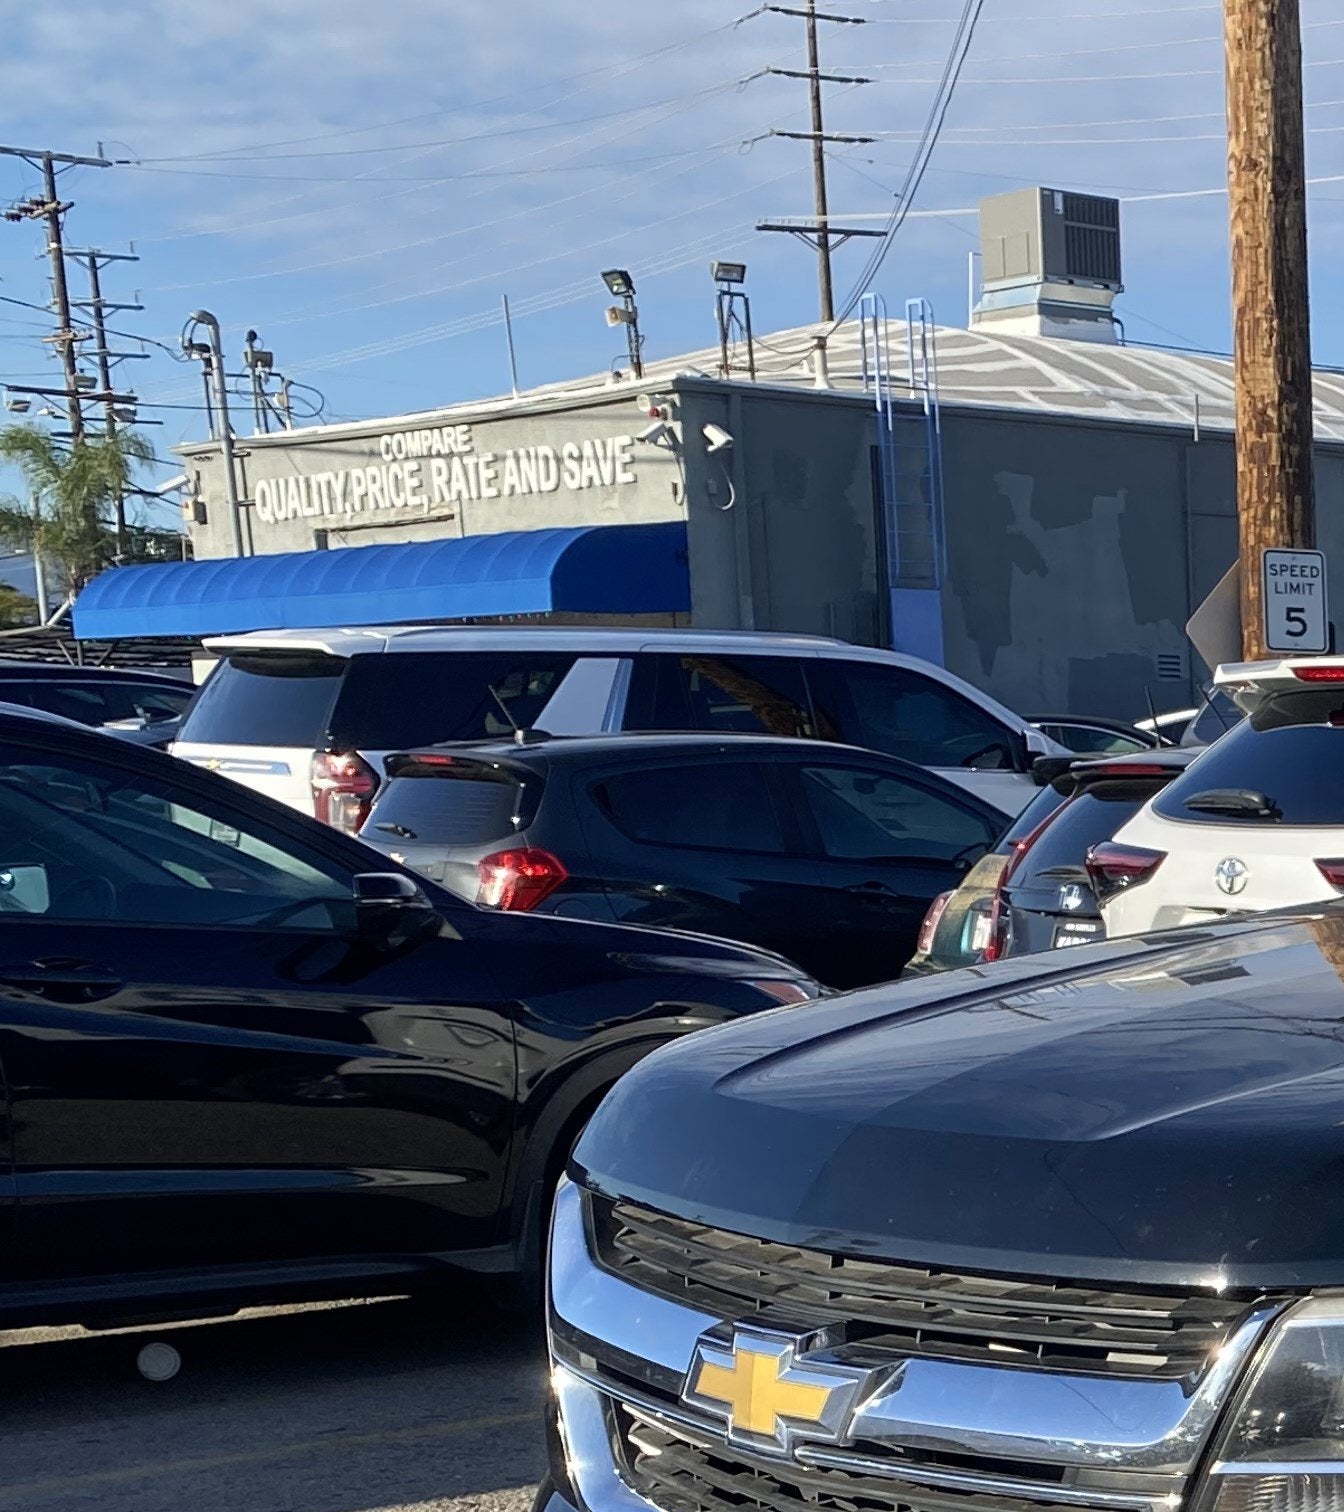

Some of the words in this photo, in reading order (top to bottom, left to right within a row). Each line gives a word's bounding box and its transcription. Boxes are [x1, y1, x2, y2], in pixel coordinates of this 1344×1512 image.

[379, 424, 473, 463] COMPARE
[430, 451, 499, 502] RATE
[502, 444, 559, 495] AND
[561, 434, 638, 487] SAVE
[1268, 563, 1320, 579] SPEED
[1274, 581, 1315, 596] LIMIT
[1285, 606, 1308, 638] 5
